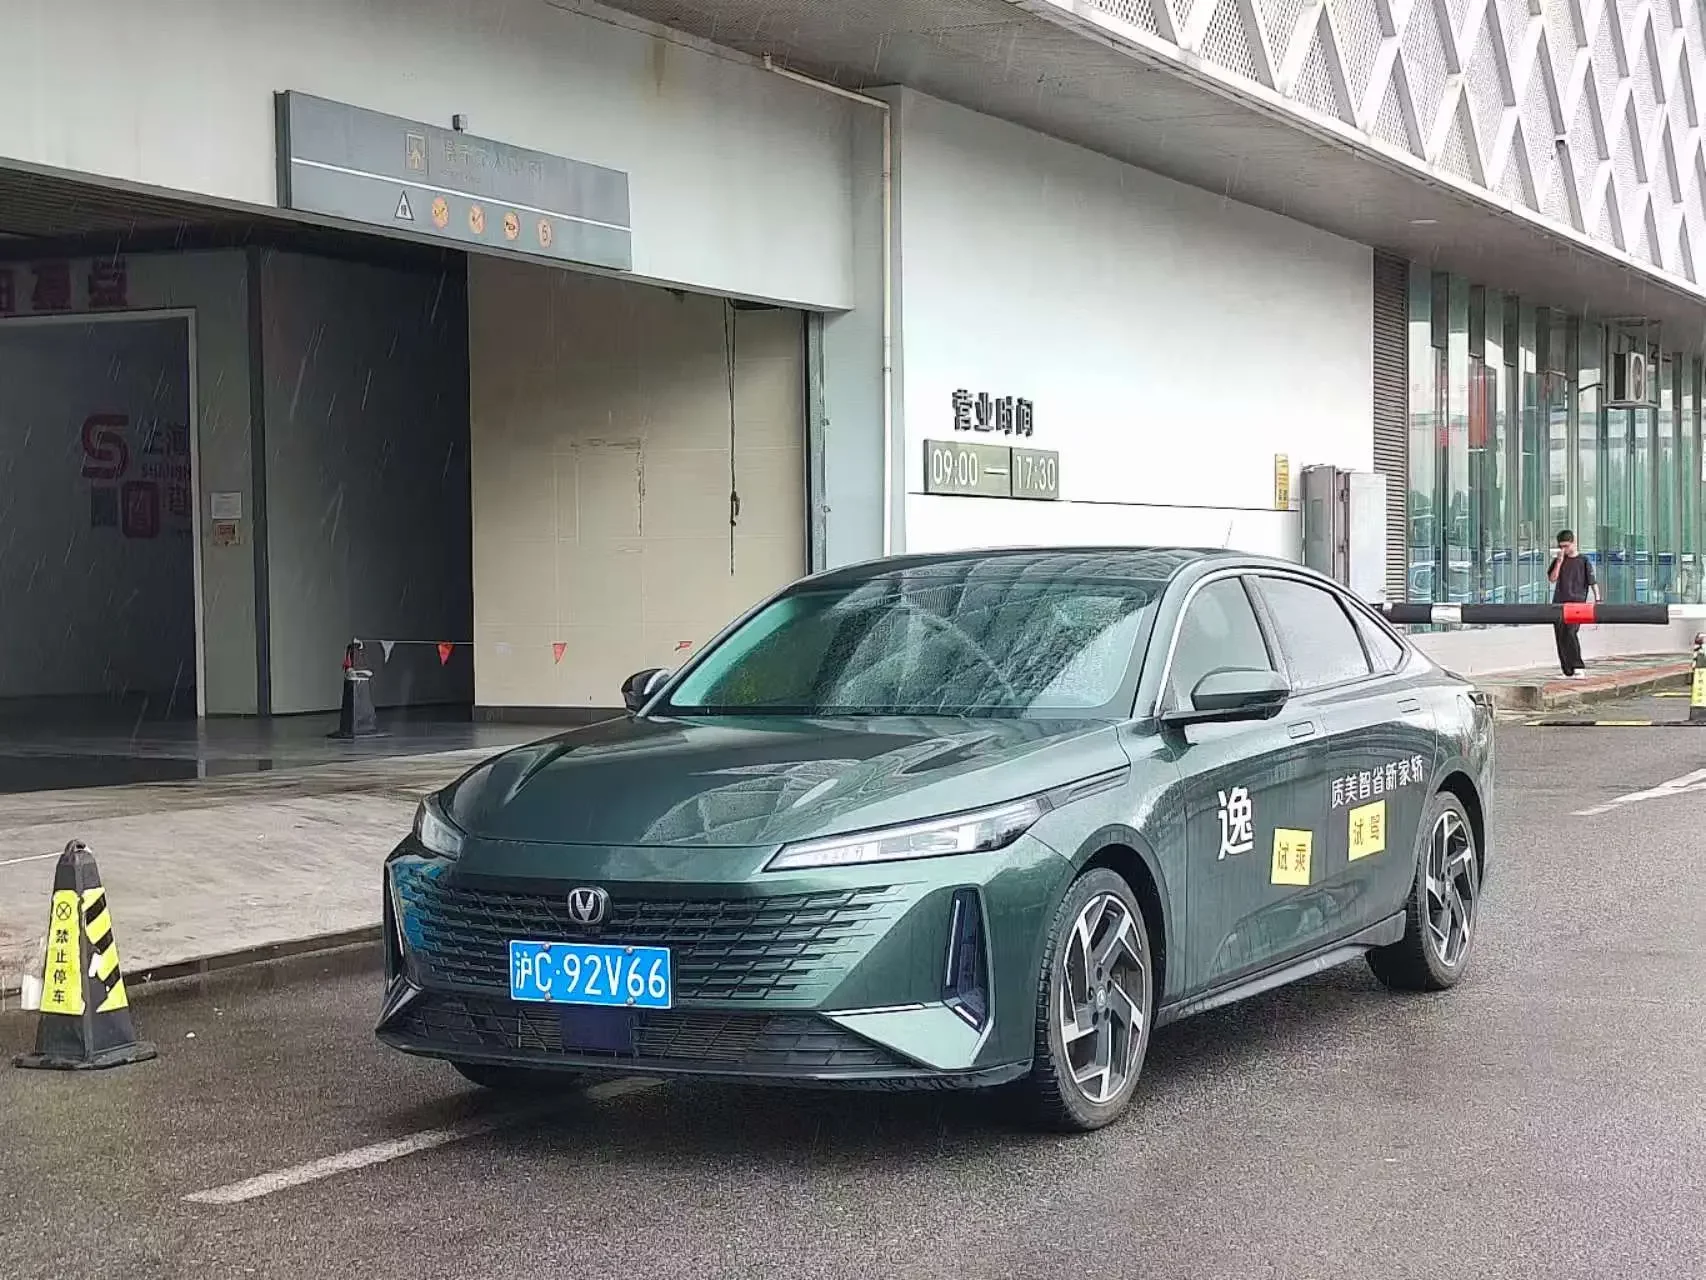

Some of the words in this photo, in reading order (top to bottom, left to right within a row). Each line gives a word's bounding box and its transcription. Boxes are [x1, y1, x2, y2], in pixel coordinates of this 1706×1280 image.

[952, 388, 1034, 437] 营业时间
[933, 448, 978, 486] 09:00
[1016, 455, 1056, 491] 17:30
[1331, 754, 1423, 809] 质美智省新家轿
[1217, 785, 1254, 861] 逸
[53, 928, 69, 1004] 禁止停车
[515, 950, 666, 998] 沪C·92V66
